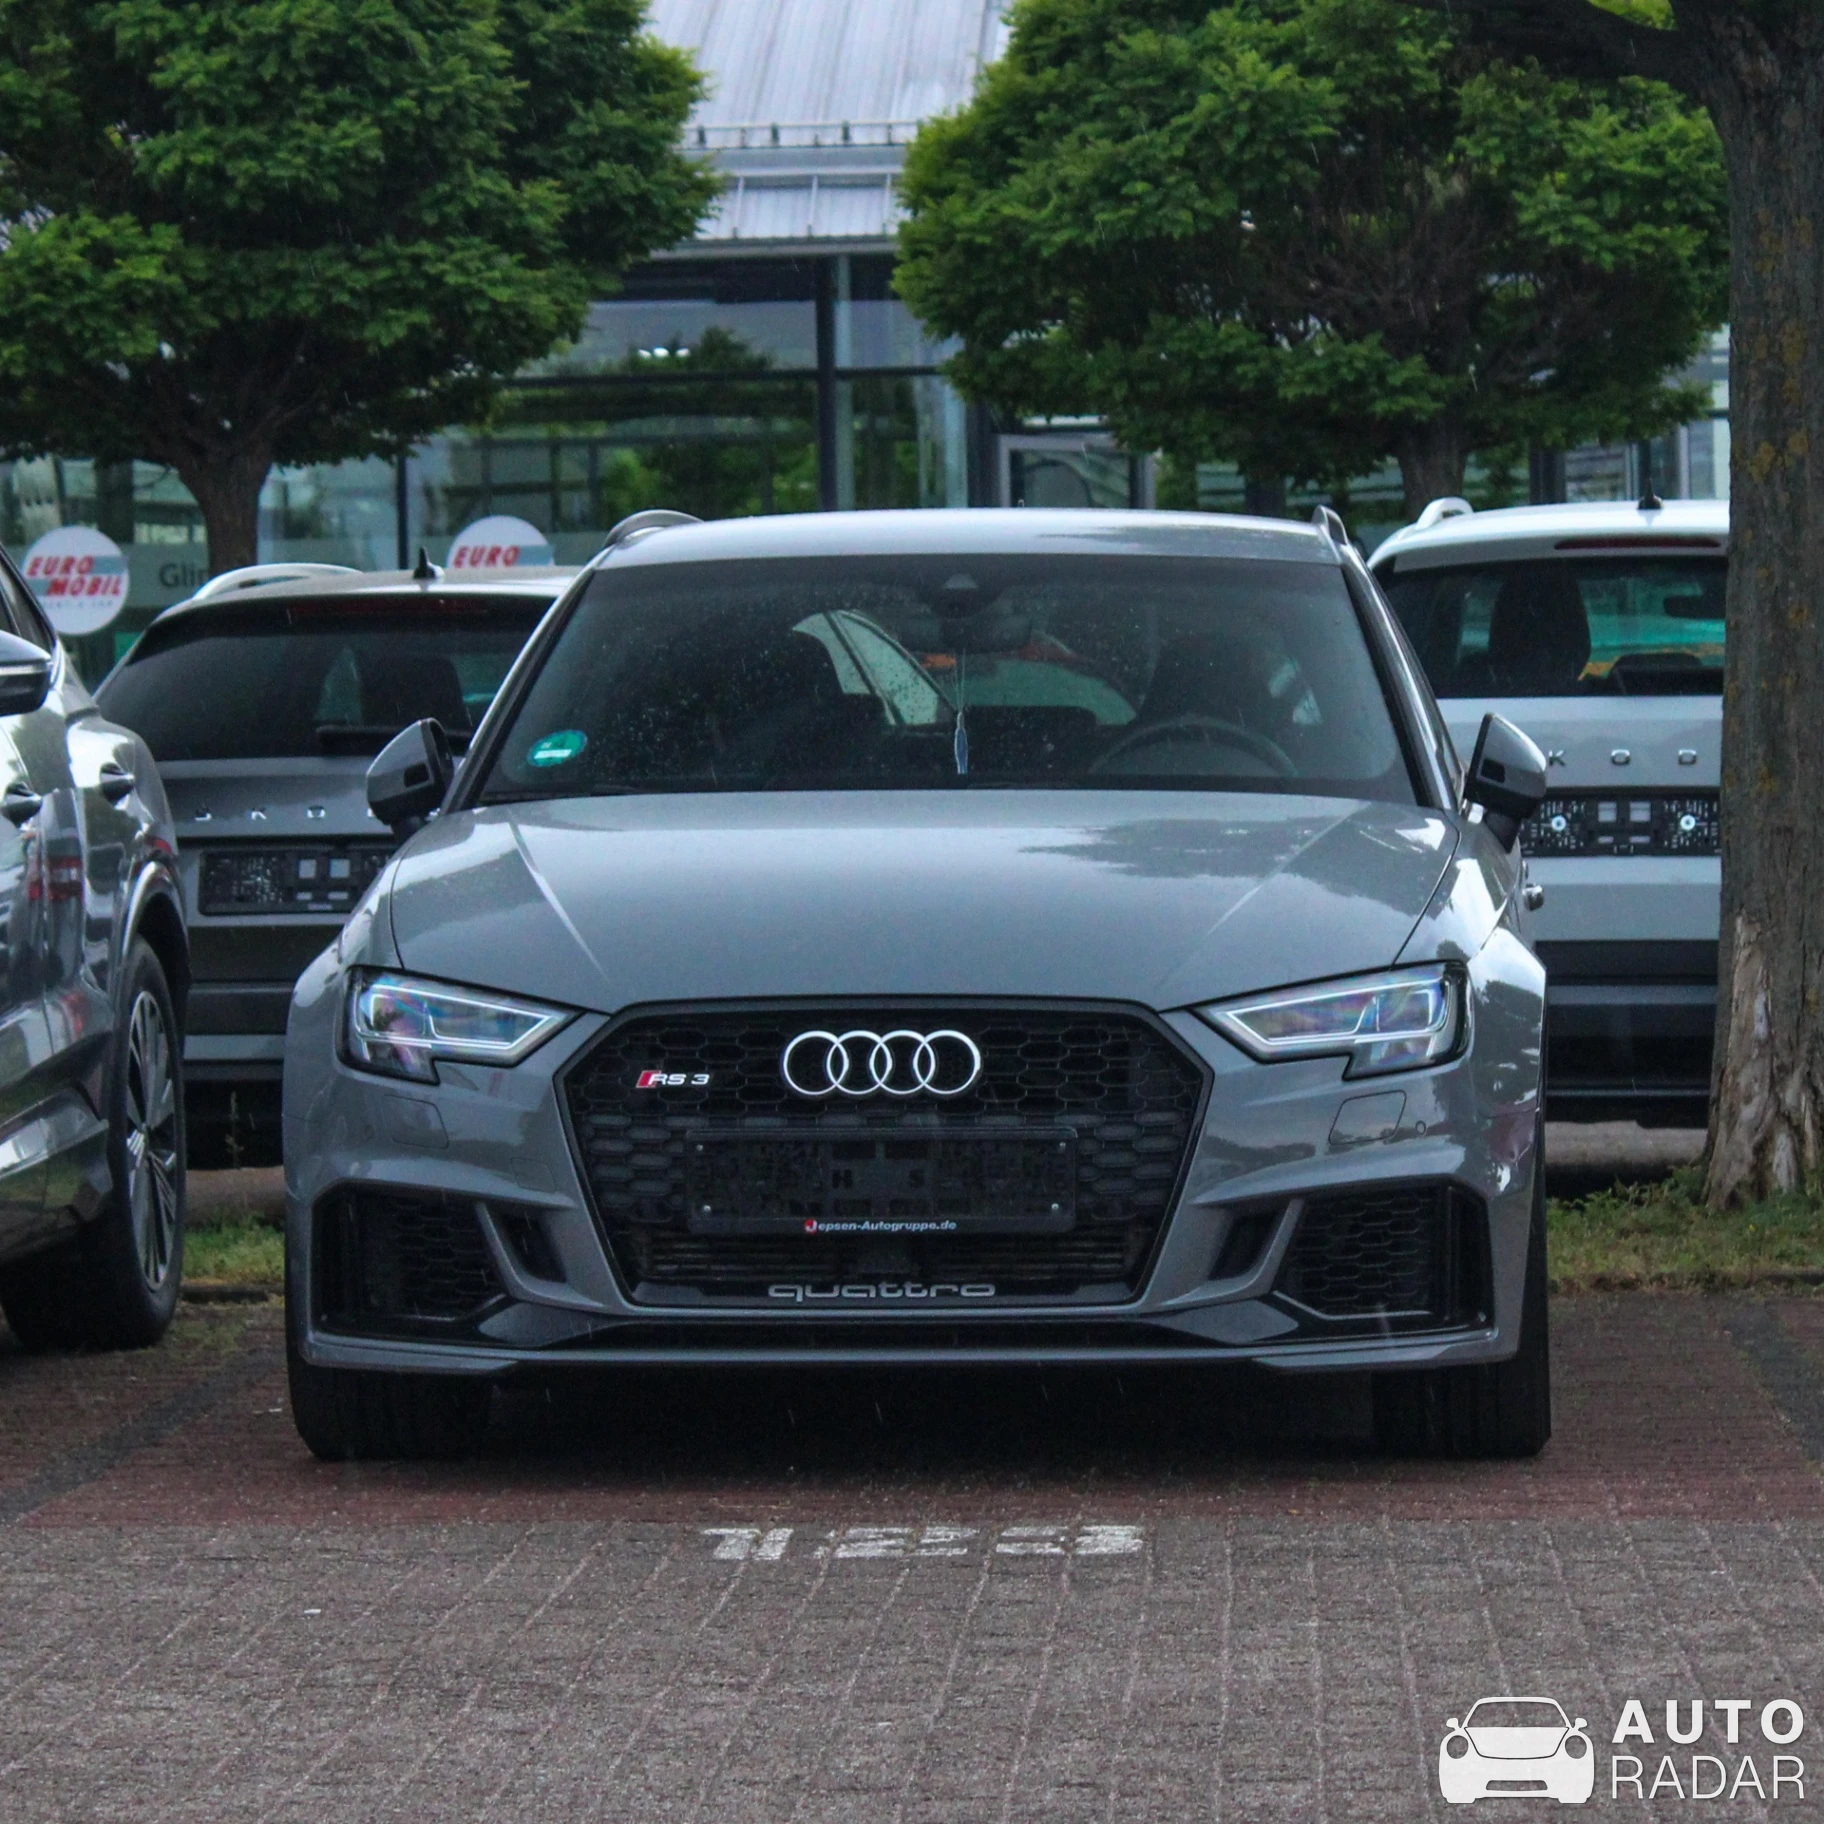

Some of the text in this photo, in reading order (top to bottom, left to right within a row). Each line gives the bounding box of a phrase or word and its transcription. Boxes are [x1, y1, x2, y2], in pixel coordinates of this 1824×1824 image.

[27, 556, 94, 577] EURO
[453, 545, 520, 569] EURO
[46, 576, 122, 597] MOBIL
[648, 1073, 710, 1086] RS 3
[804, 1219, 957, 1234] Jepsen-Autogruppe.de
[768, 1281, 996, 1303] quattro
